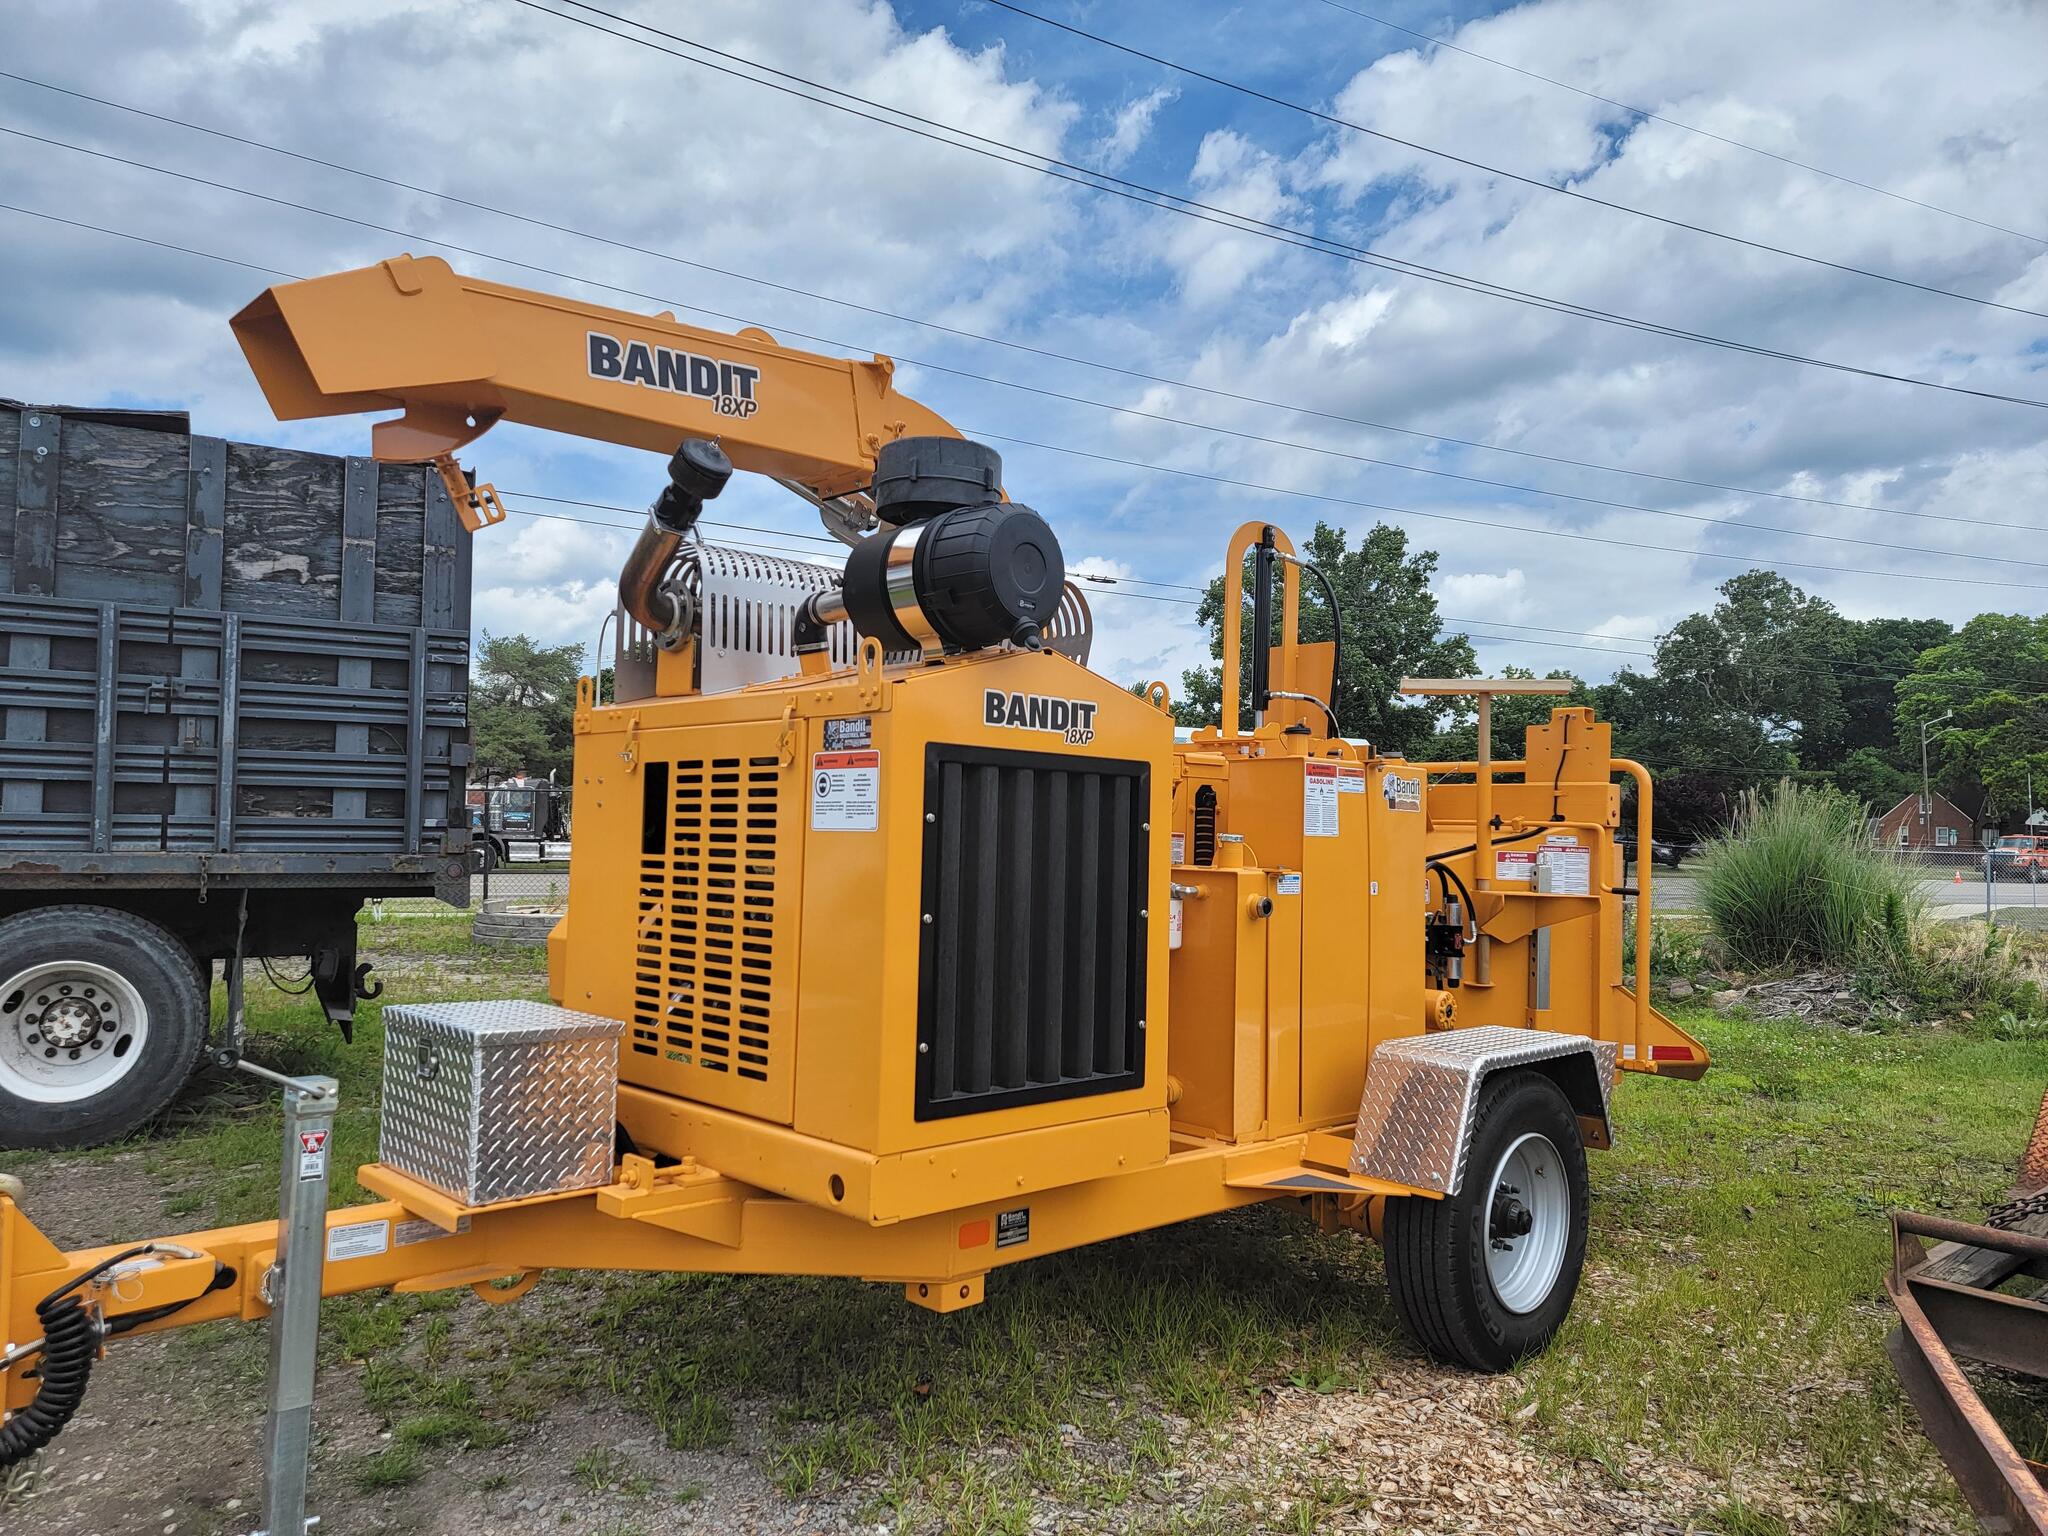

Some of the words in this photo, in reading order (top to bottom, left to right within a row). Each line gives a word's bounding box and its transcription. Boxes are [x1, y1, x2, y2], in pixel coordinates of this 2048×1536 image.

[588, 333, 759, 400] BANDIT
[712, 394, 758, 418] 18XP
[985, 690, 1097, 731] BANDIT
[839, 719, 866, 733] Bandit
[1063, 728, 1094, 745] 18XP
[1309, 778, 1334, 786] GASOLINE
[1396, 777, 1420, 795] Bandit
